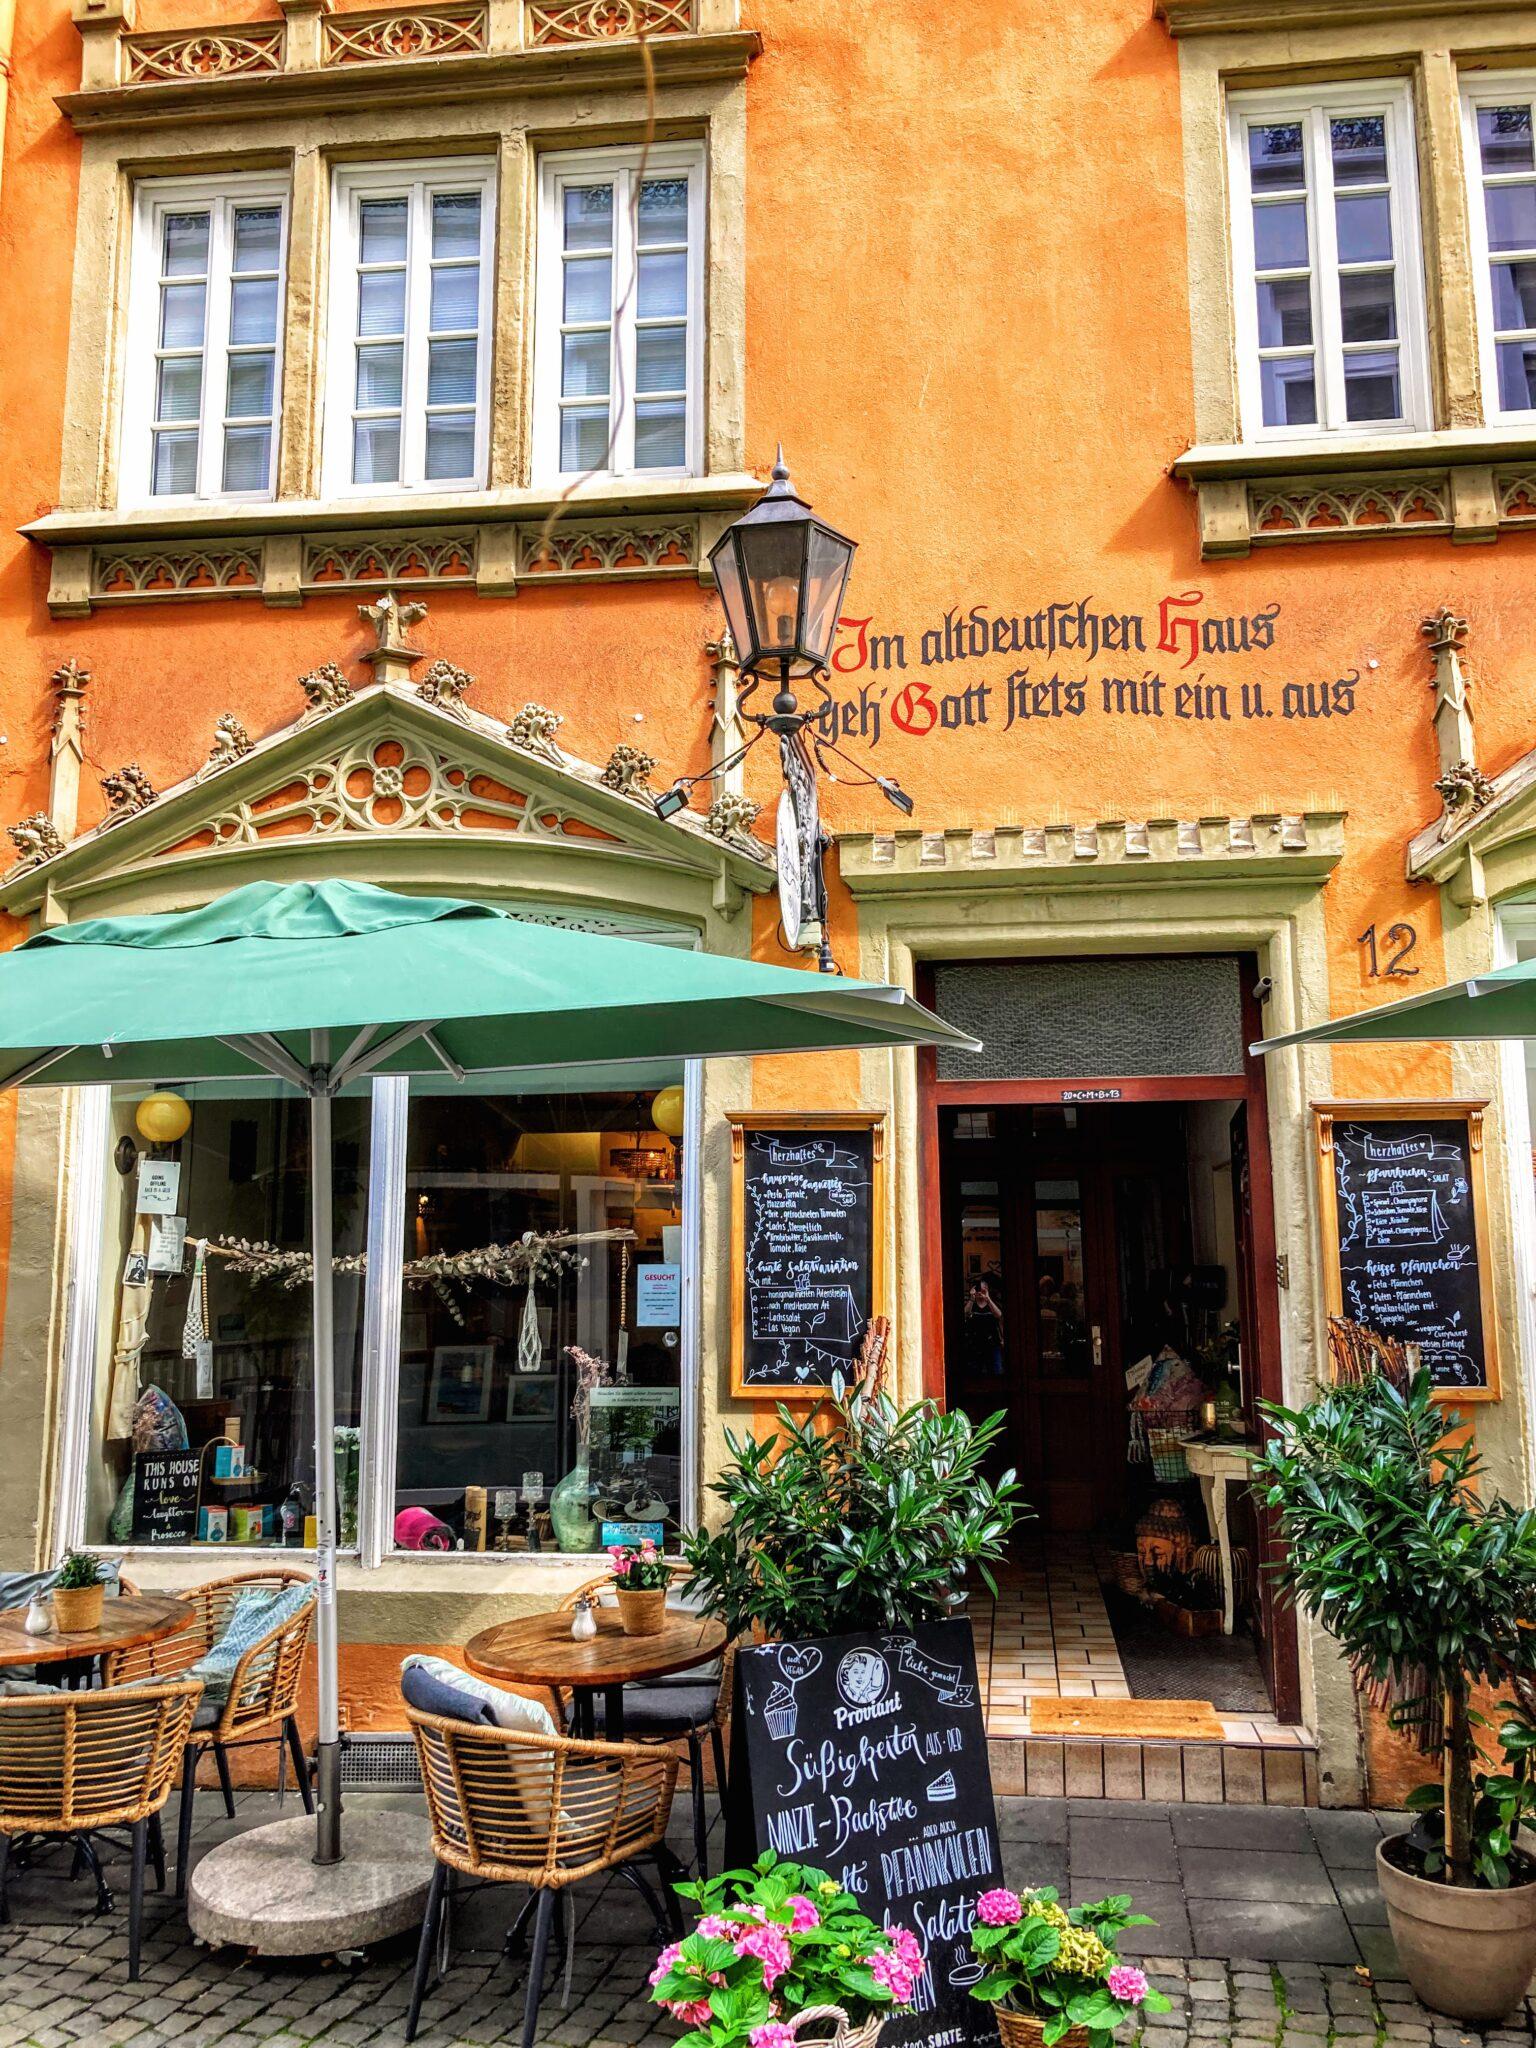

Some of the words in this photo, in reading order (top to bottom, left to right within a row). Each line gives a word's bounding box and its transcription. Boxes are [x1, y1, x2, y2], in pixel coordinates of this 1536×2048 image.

[832, 616, 908, 673] Im
[1155, 590, 1282, 670] Haus
[890, 681, 993, 736] Gott
[1100, 670, 1167, 719] mit
[1174, 673, 1233, 721] ein
[1241, 680, 1274, 719] u.
[1282, 668, 1361, 720] aus
[1357, 923, 1420, 978] 12
[772, 1146, 816, 1163] herzhaftes
[1369, 1142, 1419, 1158] herzhaftes
[169, 1459, 200, 1476] HOUSE
[143, 1476, 175, 1491] RUNS
[182, 1474, 199, 1488] ON
[151, 1528, 187, 1541] Prosecco
[785, 1664, 805, 1676] VEGAN
[834, 1691, 903, 1731] Proviant
[777, 1722, 927, 1797] Süßigkeiten
